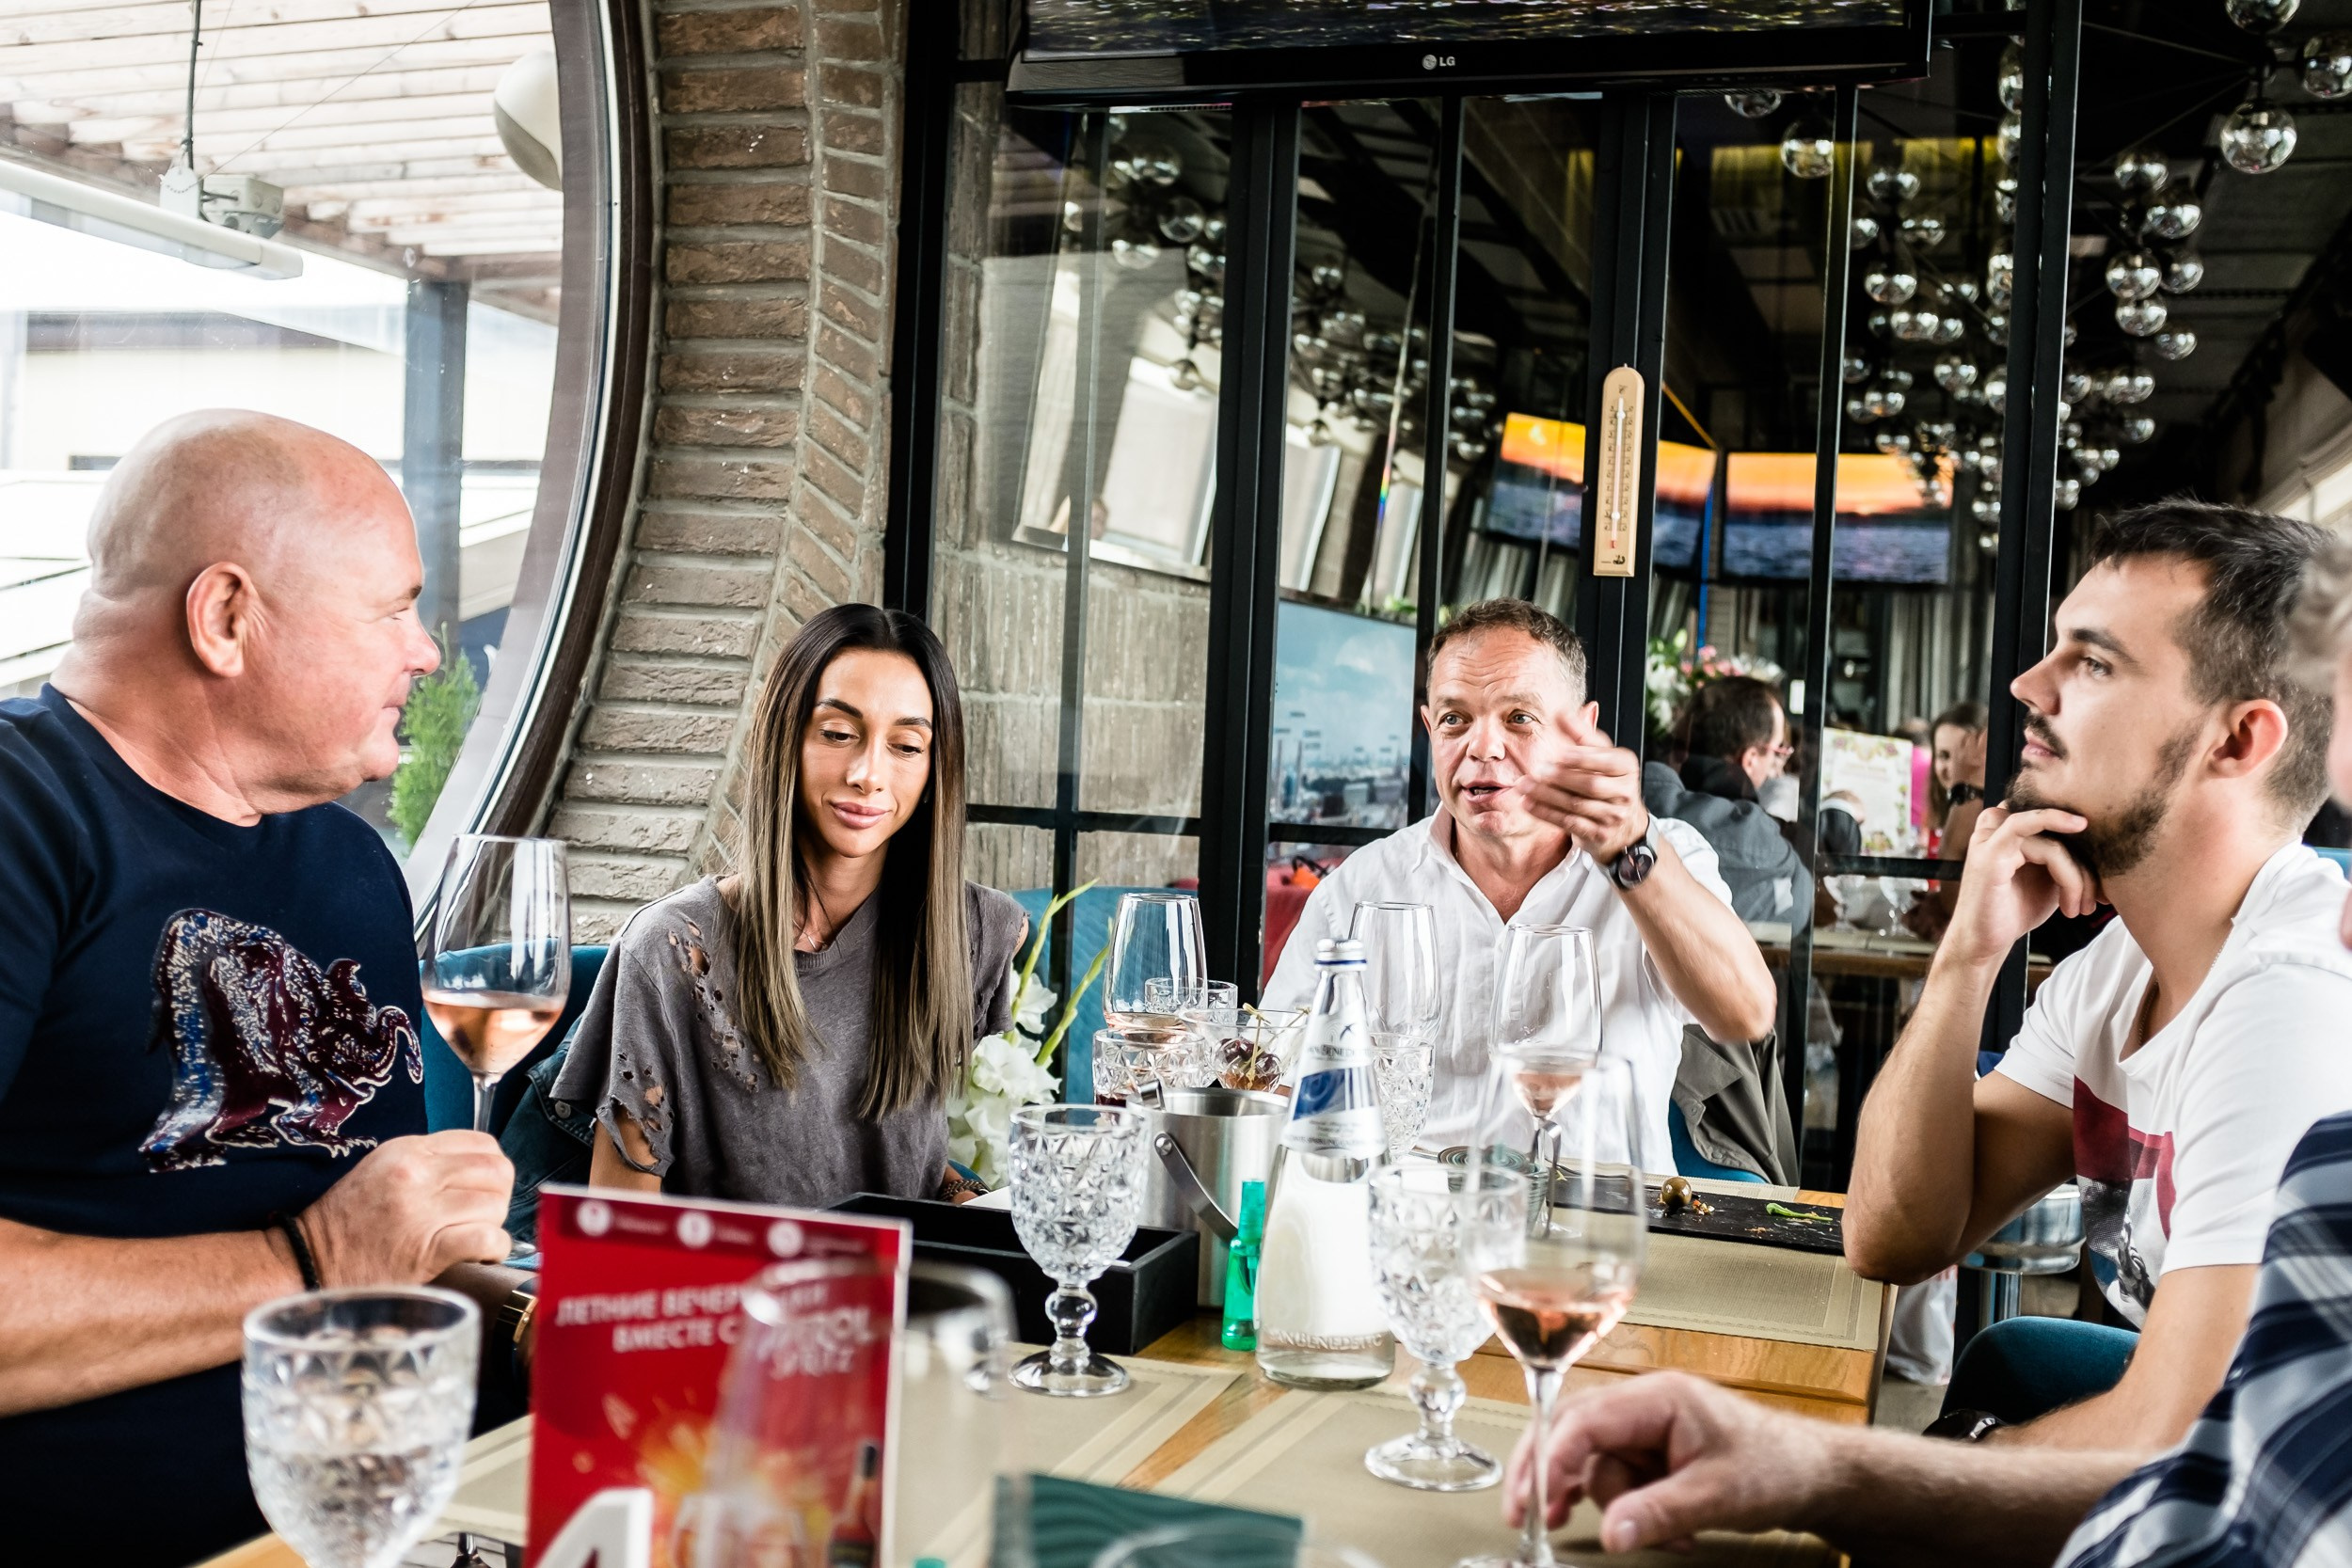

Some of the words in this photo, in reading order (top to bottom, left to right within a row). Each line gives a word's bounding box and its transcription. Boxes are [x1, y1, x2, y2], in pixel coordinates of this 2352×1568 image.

[1439, 56, 1455, 67] LG
[556, 1291, 657, 1326] ЛЕТНИЕ
[613, 1319, 714, 1352] ВМЕСТЕ
